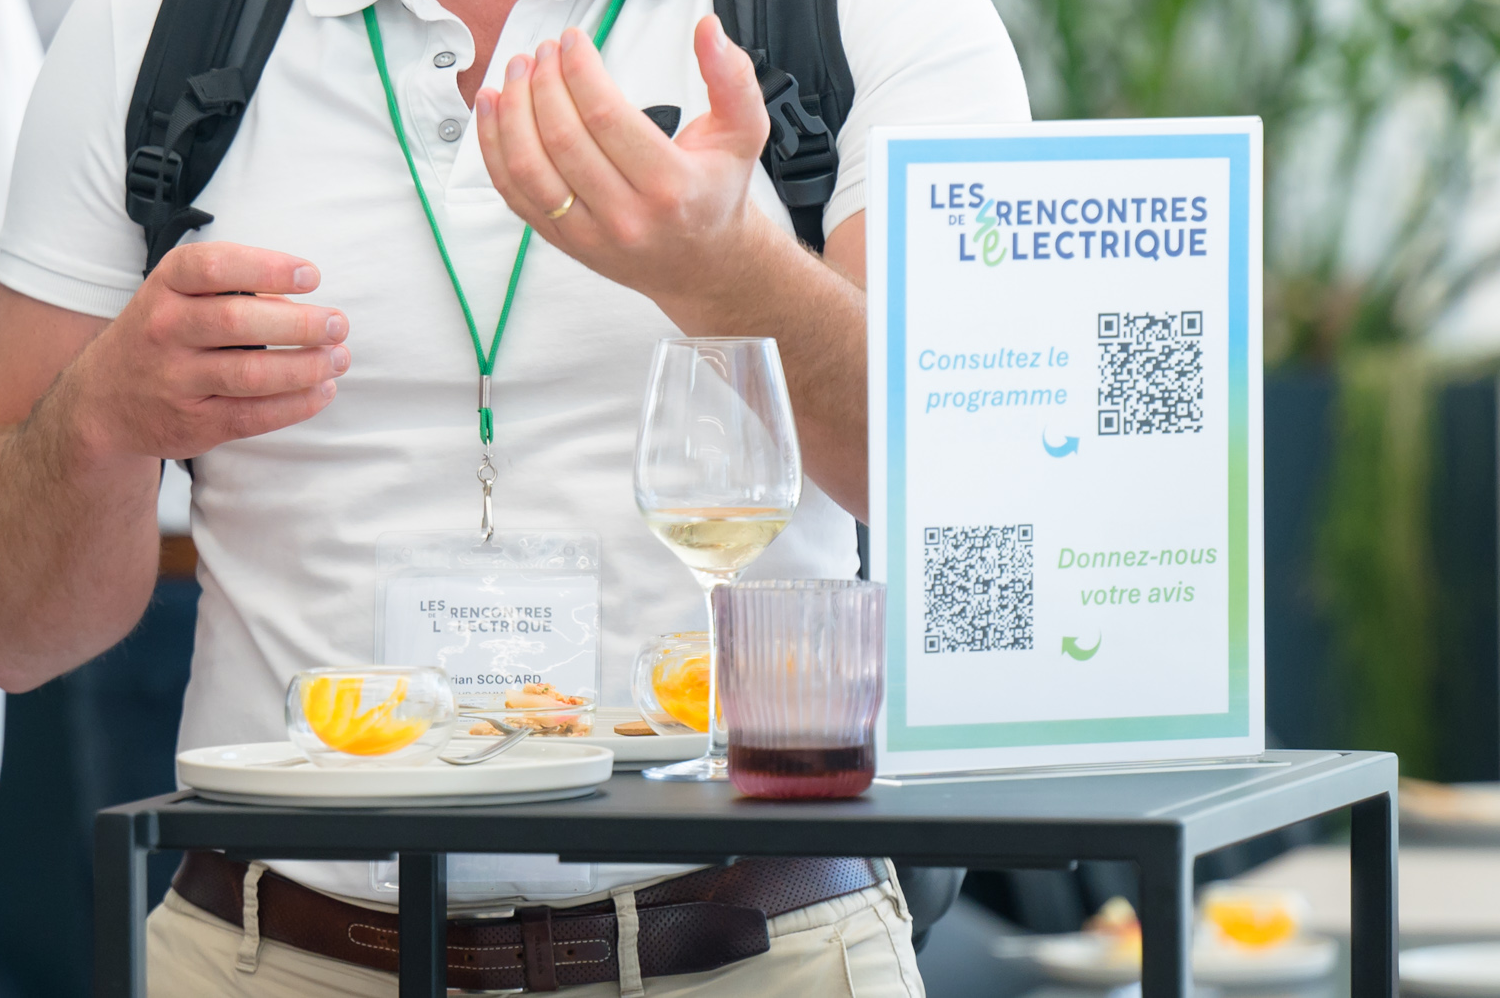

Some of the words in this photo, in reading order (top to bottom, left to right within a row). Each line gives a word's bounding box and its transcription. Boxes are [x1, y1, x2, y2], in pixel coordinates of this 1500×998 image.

[930, 182, 985, 209] LES
[948, 214, 966, 226] DE
[995, 195, 1208, 227] RENCONTRES
[918, 347, 1042, 372] Consultez
[1047, 346, 1070, 368] le
[925, 387, 1068, 414] programme
[1057, 547, 1218, 570] Donnez-nous
[420, 599, 446, 612] LES
[1080, 585, 1142, 606] votre
[1147, 581, 1196, 604] avis
[450, 606, 553, 619] RENCONTRES
[450, 675, 473, 685] rian
[476, 674, 543, 686] SCOCARD
